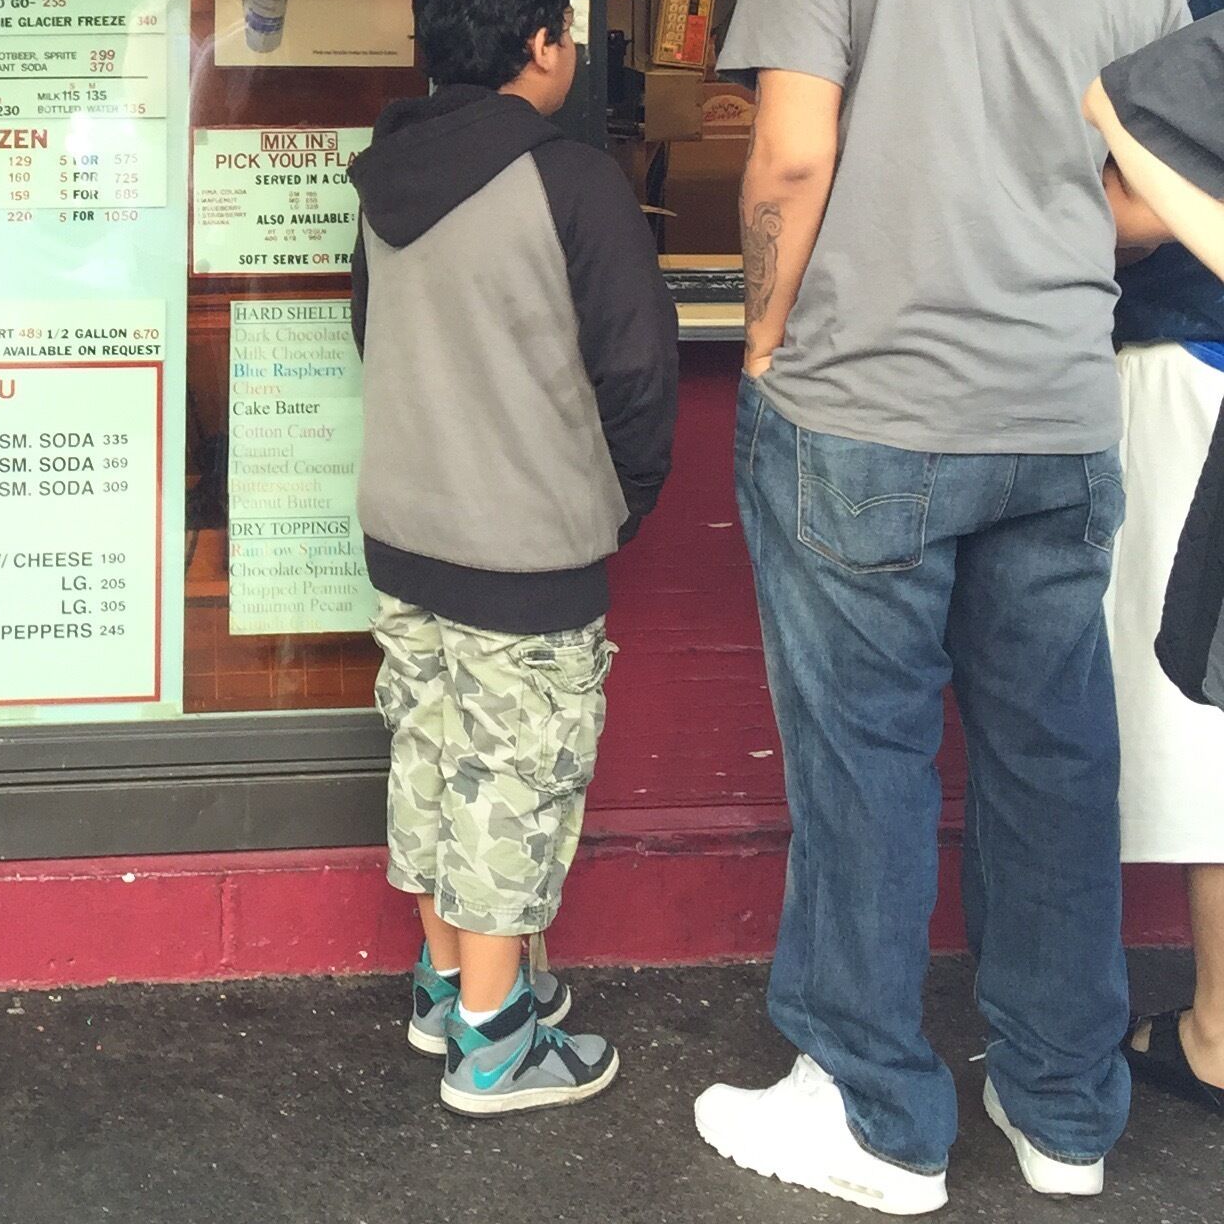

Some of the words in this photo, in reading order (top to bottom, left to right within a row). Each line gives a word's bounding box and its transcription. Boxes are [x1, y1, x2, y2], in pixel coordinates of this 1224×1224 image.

[265, 135, 297, 148] MIX
[216, 153, 260, 168] PICK
[268, 153, 316, 168] YOUR
[325, 151, 358, 167] FLA
[255, 175, 301, 185] SERVED
[306, 174, 317, 184] IN
[322, 174, 329, 184] A
[333, 173, 352, 184] CU
[257, 215, 284, 225] ALSO
[291, 213, 354, 224] AVAILABLE:
[239, 254, 267, 265] SOFT
[273, 254, 309, 265] SERVE
[312, 254, 329, 264] OR
[236, 307, 283, 320] HARD
[287, 306, 338, 319] SHELL
[234, 328, 270, 342] Dark
[275, 327, 349, 342] Chocolate
[272, 346, 344, 360] Chocolate
[234, 364, 267, 377] Blue
[273, 363, 345, 379] Raspberry
[234, 402, 270, 416] Cake
[275, 401, 320, 415] Batter
[233, 424, 282, 438] Cotton
[287, 424, 335, 441] Candy
[0, 433, 32, 449] SM.
[40, 433, 95, 449] SODA
[103, 434, 128, 446] 335
[0, 457, 31, 473] SM.
[39, 456, 94, 472] SODA
[103, 458, 128, 469] 369
[231, 461, 288, 475] Toasted
[294, 460, 354, 474] Coconut
[0, 481, 31, 497] SM.
[39, 480, 94, 496] SODA
[103, 481, 128, 493] 309
[287, 495, 332, 509] Butter
[232, 522, 265, 537] DRY
[271, 520, 348, 535] TOPPINGS
[14, 552, 93, 568] CHEESE
[101, 553, 125, 564] 190
[231, 561, 302, 577] Chocolate
[61, 577, 92, 592] LG.
[101, 578, 126, 590] 205
[61, 600, 92, 615] LG.
[101, 601, 126, 612] 305
[1, 623, 92, 640] PEPPERS
[100, 625, 125, 637] 245
